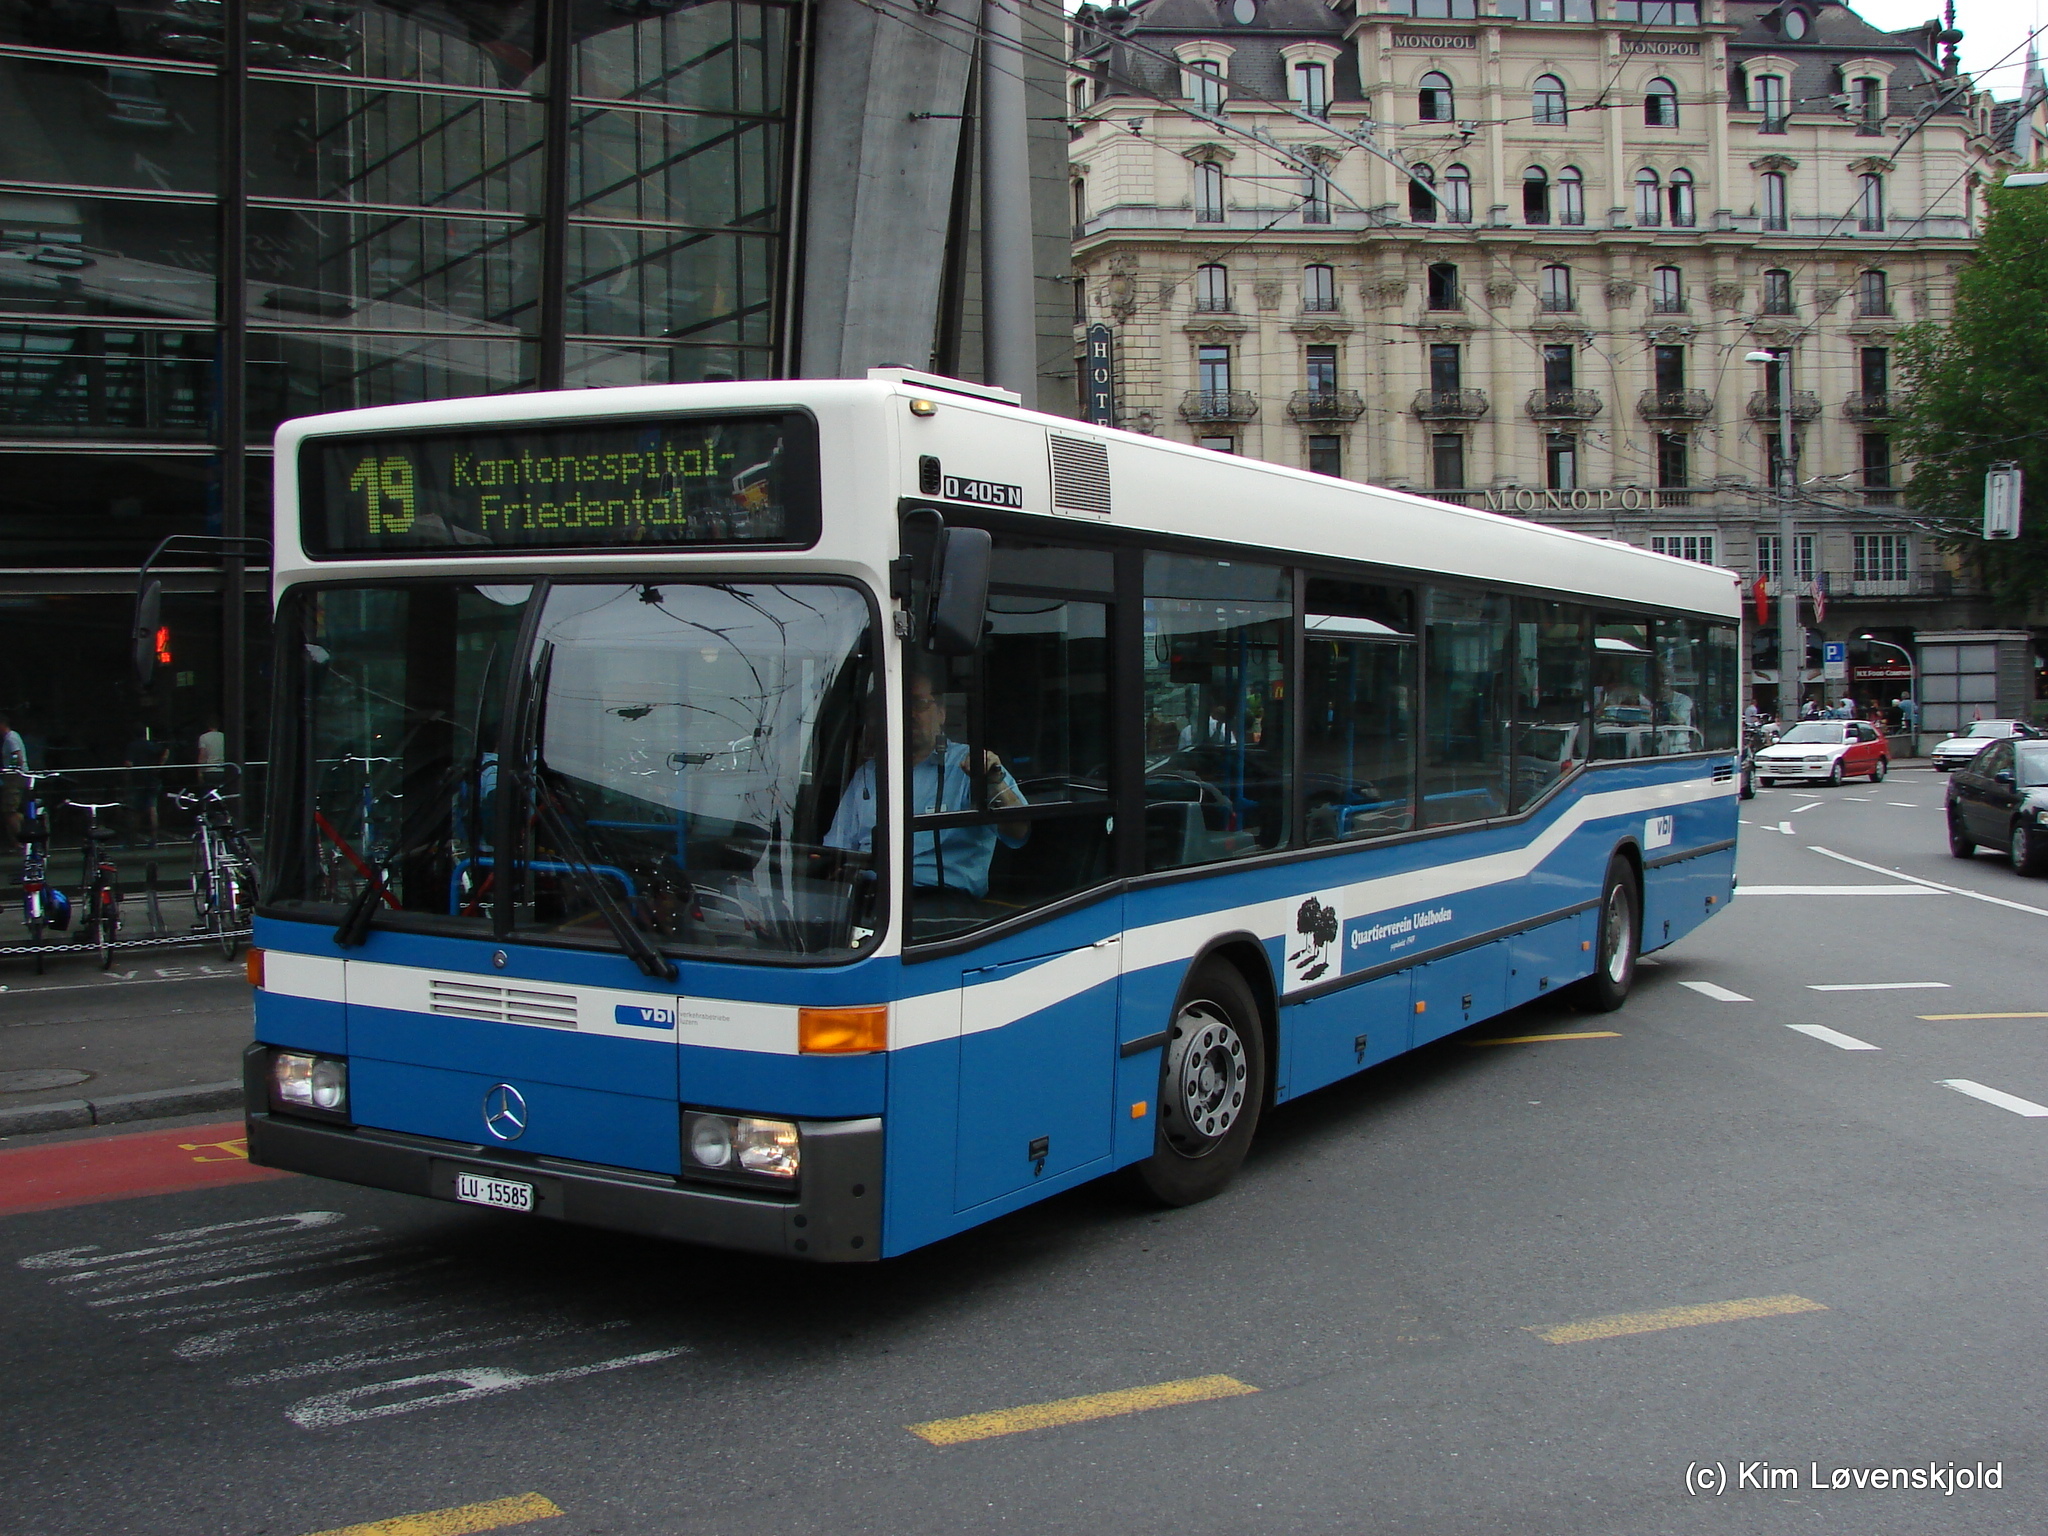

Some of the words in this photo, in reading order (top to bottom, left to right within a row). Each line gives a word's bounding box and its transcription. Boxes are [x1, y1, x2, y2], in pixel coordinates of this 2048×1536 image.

[1394, 34, 1475, 49] MONOPOL
[1622, 40, 1700, 55] MONOPOL
[453, 438, 735, 488] Kantonsspital-
[350, 456, 414, 534] 19
[1484, 488, 1666, 512] MONOPOL
[480, 487, 687, 531] Friedental
[1656, 815, 1671, 836] vbl
[1350, 916, 1412, 949] Quartierverein
[1413, 907, 1452, 930] Udelboden
[103, 961, 249, 980] VEL
[640, 1007, 674, 1024] vbl
